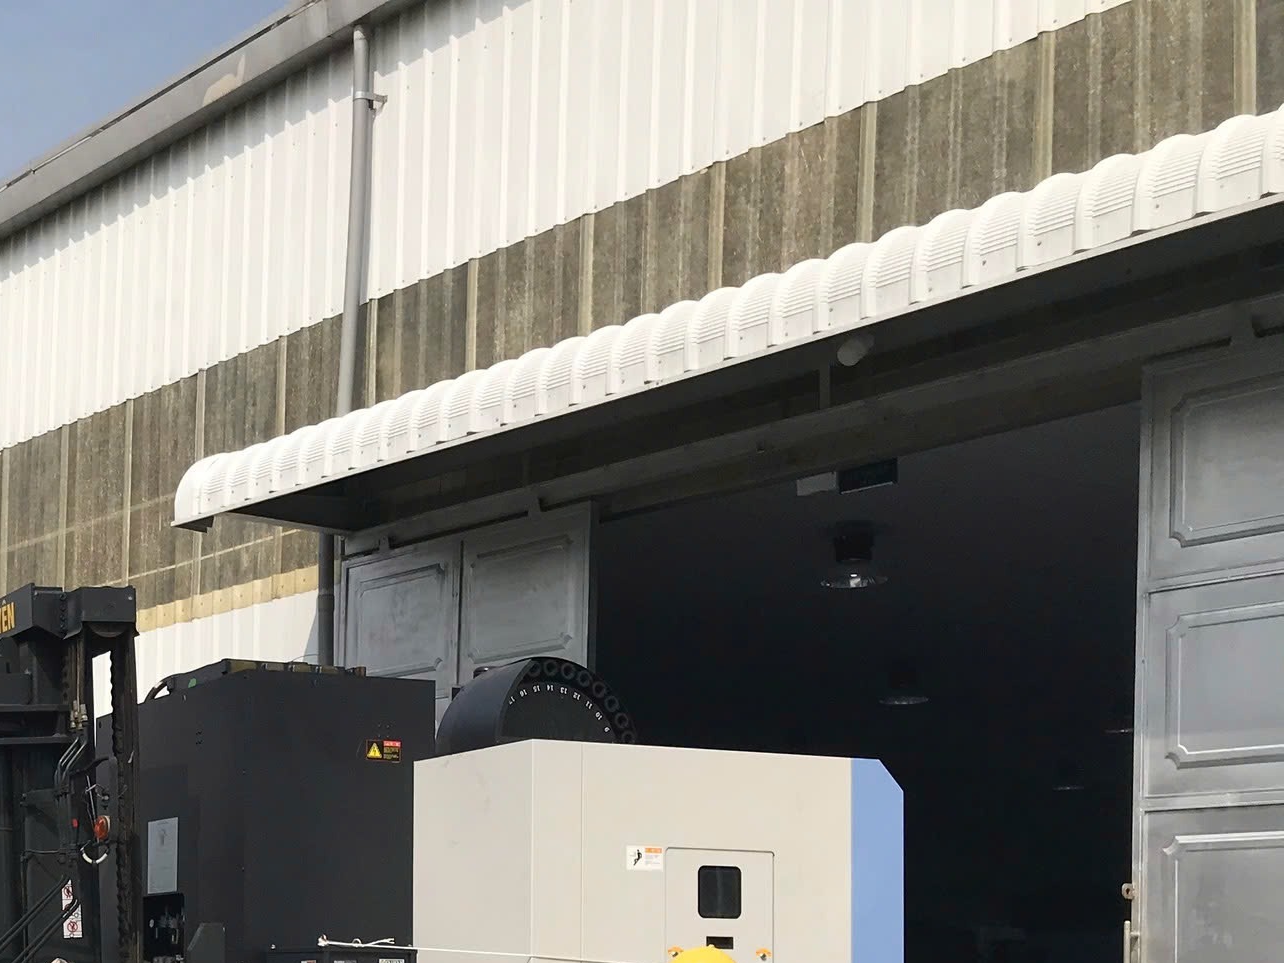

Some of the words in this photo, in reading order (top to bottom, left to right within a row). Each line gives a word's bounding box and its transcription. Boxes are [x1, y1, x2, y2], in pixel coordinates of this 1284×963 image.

[532, 684, 541, 693] 15
[546, 684, 554, 692] 14
[560, 686, 568, 695] 13
[519, 689, 527, 698] 16
[572, 691, 581, 701] 12
[585, 700, 593, 710] 11
